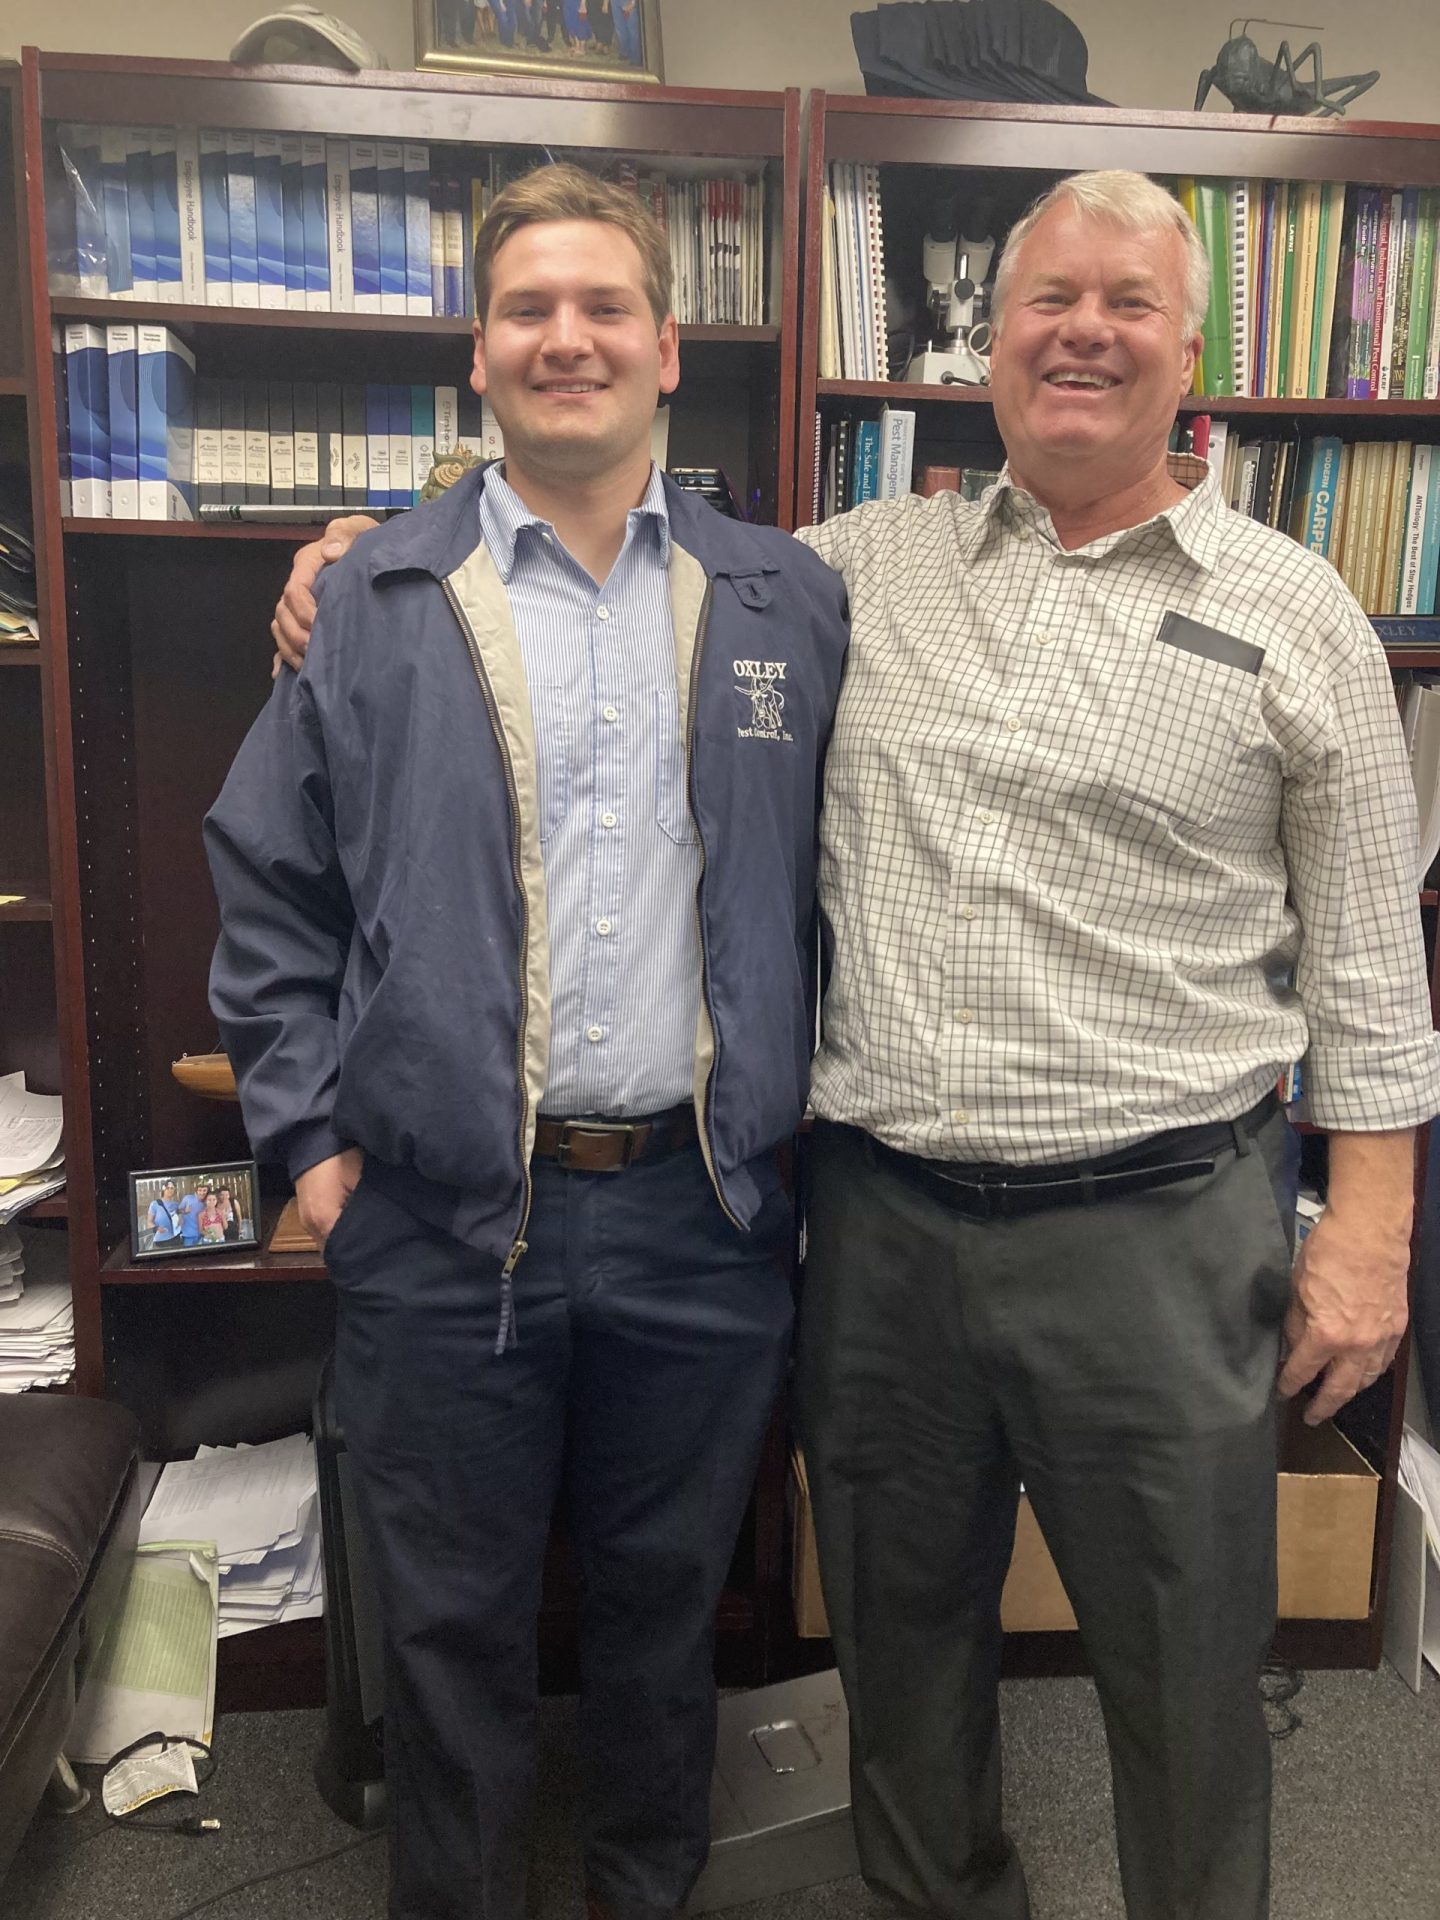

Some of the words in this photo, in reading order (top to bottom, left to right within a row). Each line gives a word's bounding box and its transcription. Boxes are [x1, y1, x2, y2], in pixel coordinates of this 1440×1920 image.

[183, 160, 194, 198] Employee
[333, 174, 344, 210] Employee
[186, 201, 198, 241] Handbook
[335, 214, 346, 253] Handbook
[1377, 248, 1387, 286] Industrial,
[1402, 261, 1410, 291] Landscape
[1377, 286, 1385, 300] and
[1373, 302, 1383, 346] Institutional
[1398, 318, 1406, 347] Diagnostic
[1372, 347, 1380, 362] Pest
[1370, 364, 1379, 391] Control
[891, 418, 904, 441] Pest
[864, 436, 873, 453] The
[864, 454, 872, 472] Safe
[1321, 448, 1333, 488] MODERN
[863, 473, 871, 489] and
[1412, 495, 1423, 531] ANThology:
[1412, 533, 1420, 545] The
[1410, 546, 1418, 560] Best
[1409, 561, 1417, 569] of
[1406, 585, 1415, 608] Hedges
[1374, 625, 1417, 637] XLEY
[733, 660, 787, 679] OXLEY
